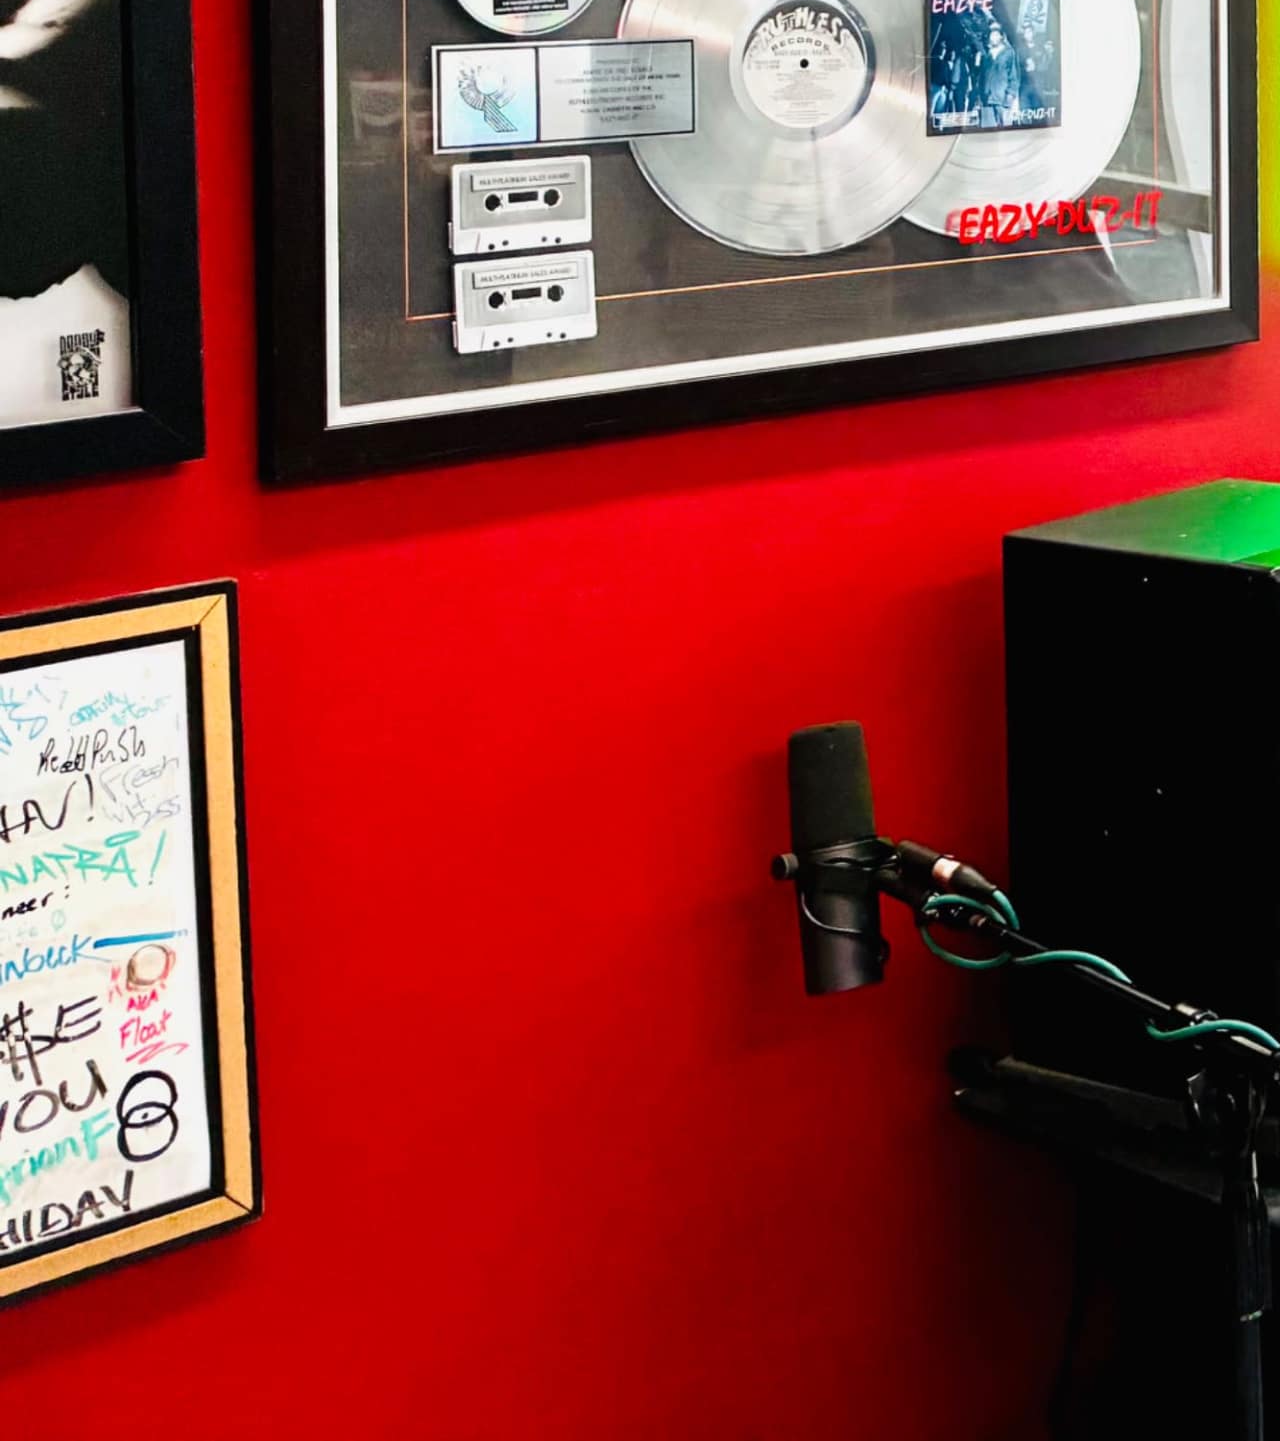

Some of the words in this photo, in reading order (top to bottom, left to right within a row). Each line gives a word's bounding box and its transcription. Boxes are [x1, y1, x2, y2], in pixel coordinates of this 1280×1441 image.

[760, 6, 850, 46] RUTHLESS
[771, 36, 830, 52] RECORDS
[953, 192, 1164, 245] EAZY-DUZ-IT
